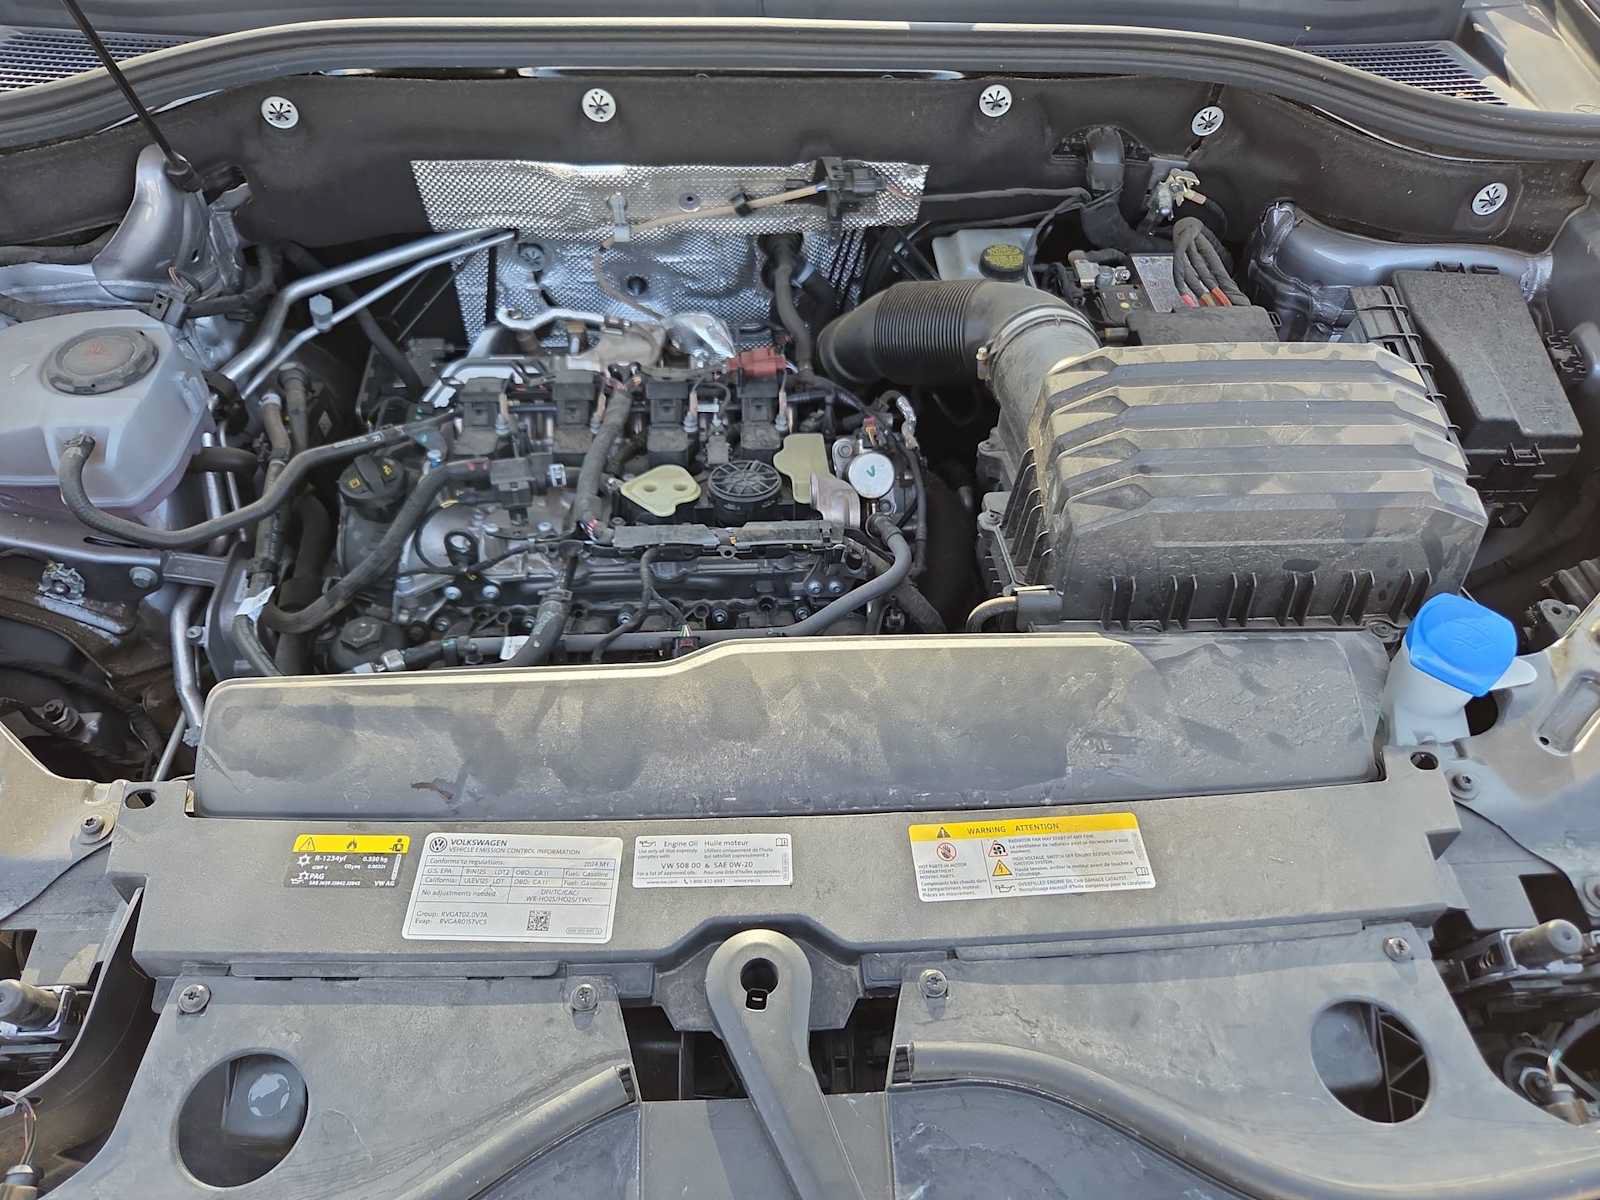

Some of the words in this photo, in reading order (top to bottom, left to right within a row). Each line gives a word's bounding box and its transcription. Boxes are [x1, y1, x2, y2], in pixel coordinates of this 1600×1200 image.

[967, 825, 1007, 834] WARNING
[1015, 823, 1059, 832] ATTENTION
[450, 839, 508, 847] VOLKSWAGEN
[664, 840, 687, 849] Engine
[704, 839, 721, 847] Huile
[473, 846, 505, 854] EMISSION
[506, 847, 535, 855] CONTROL
[536, 848, 581, 856] INFORMATION
[314, 854, 348, 864] R-1234yf
[430, 857, 459, 866] Conforms
[676, 861, 689, 869] 508
[691, 861, 701, 869] 00
[729, 860, 753, 868] 0W-20
[309, 872, 325, 880] PAG
[422, 888, 431, 896] No
[432, 888, 471, 898] adjustments
